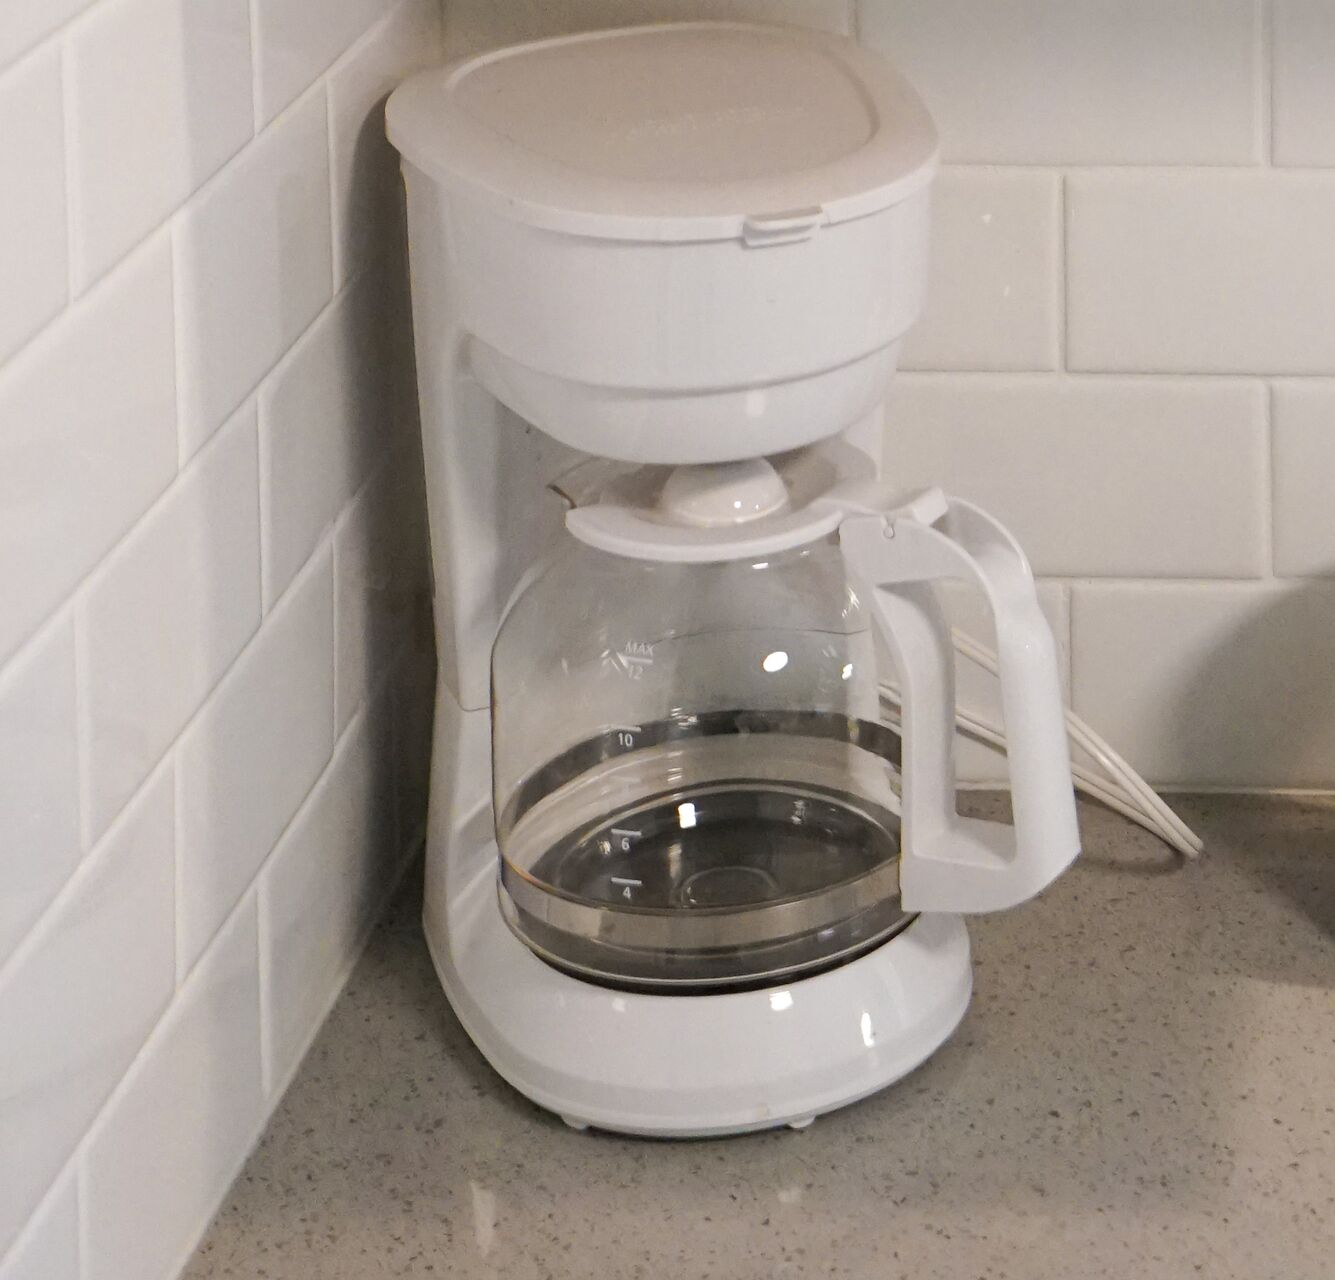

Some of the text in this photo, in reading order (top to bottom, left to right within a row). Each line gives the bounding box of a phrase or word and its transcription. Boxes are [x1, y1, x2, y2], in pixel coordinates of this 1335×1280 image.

[625, 641, 654, 656] MAX
[617, 732, 634, 748] 10
[620, 837, 631, 852] 6
[622, 886, 632, 900] 4
